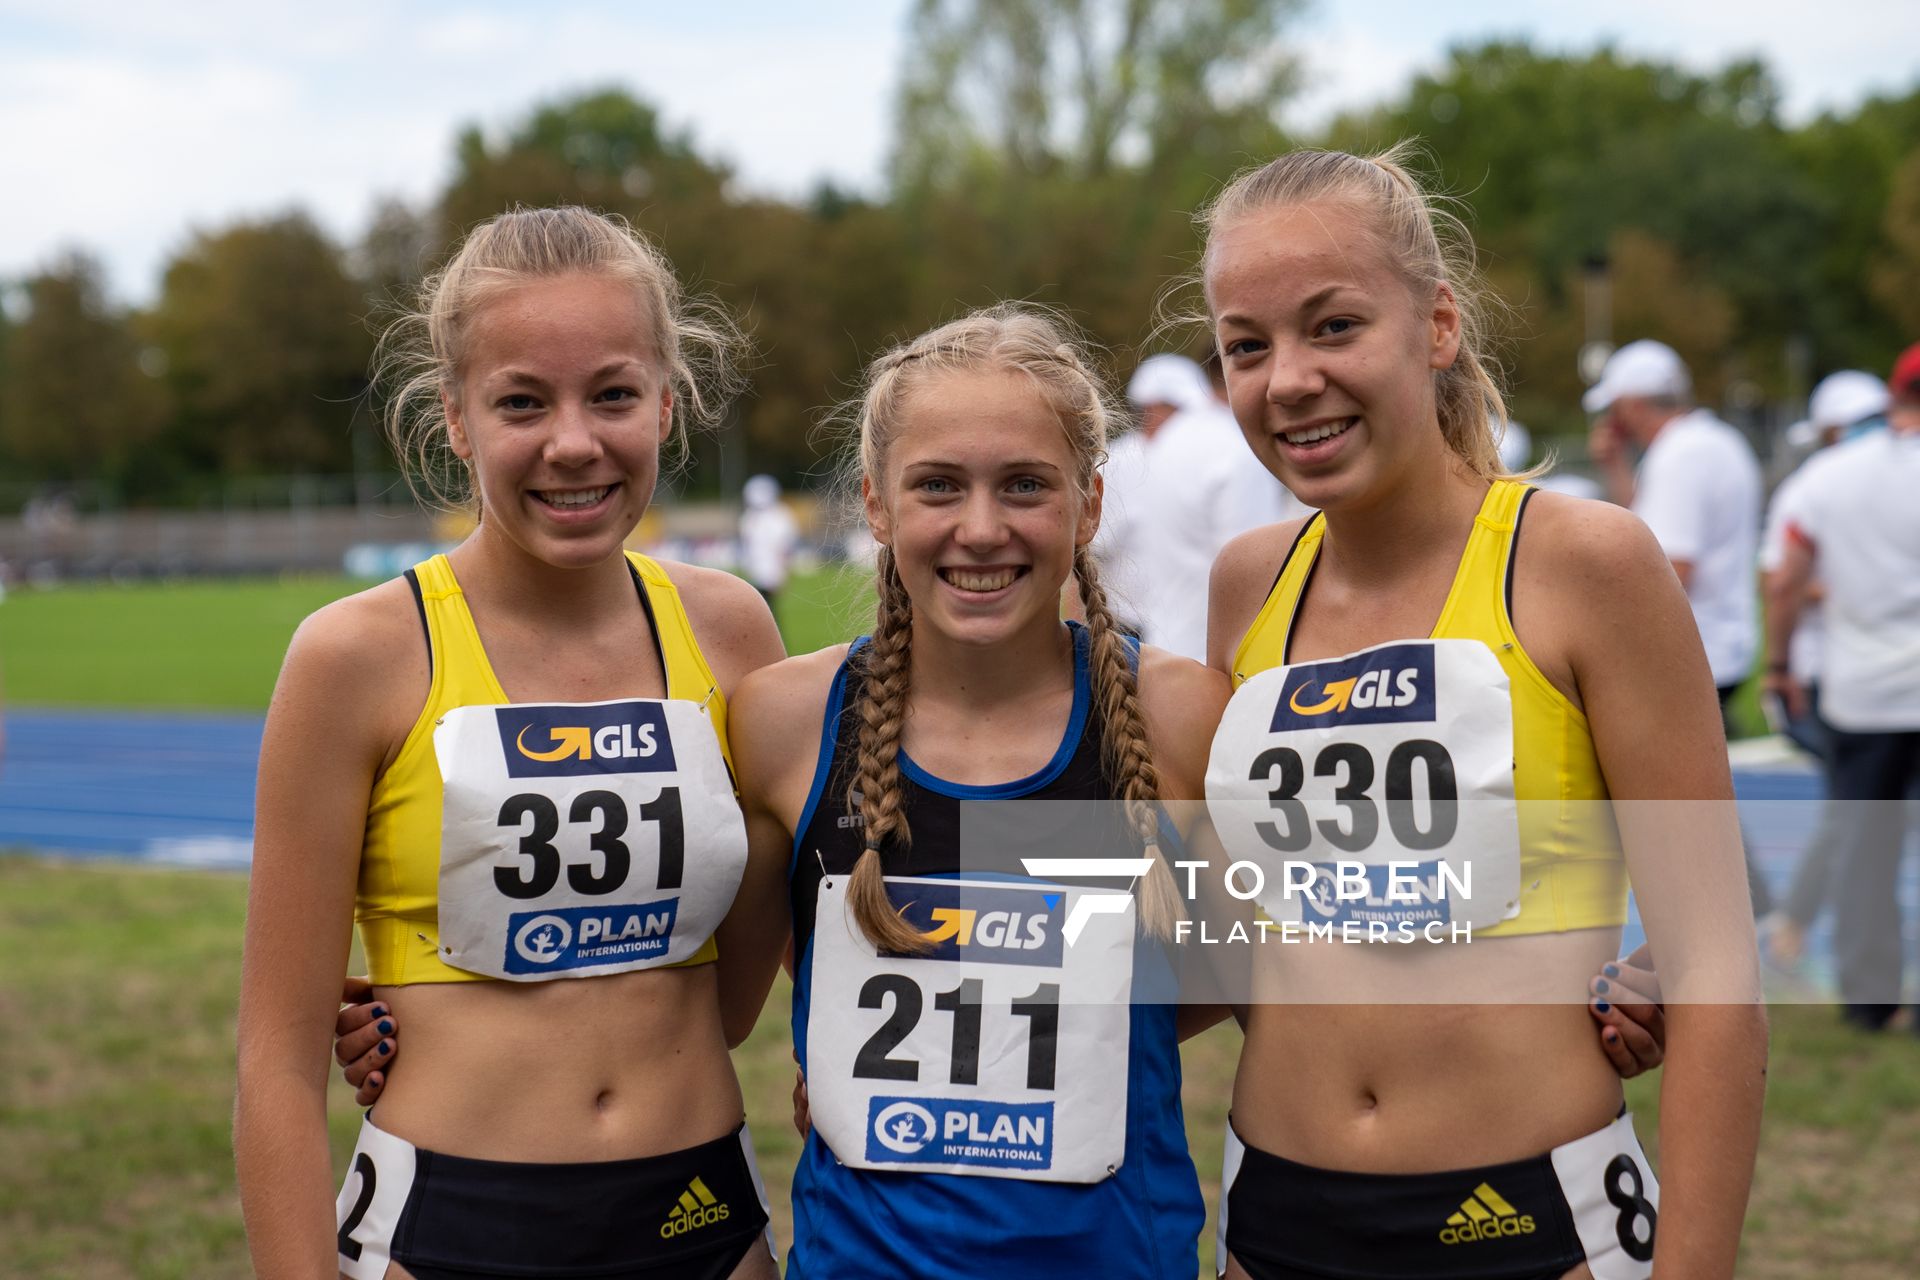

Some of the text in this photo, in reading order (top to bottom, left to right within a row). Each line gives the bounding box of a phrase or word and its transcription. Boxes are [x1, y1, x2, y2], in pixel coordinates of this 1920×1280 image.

[1351, 668, 1418, 709] GLS
[593, 723, 657, 759] GLS
[1248, 739, 1458, 853] 330
[493, 786, 685, 899] 331
[578, 912, 670, 944] PLAN
[975, 911, 1048, 950] GLS
[1351, 909, 1441, 922] INTERNATIONAL
[577, 939, 662, 958] INTERNATIONAL
[852, 973, 1060, 1091] 211
[943, 1110, 1046, 1146] PLAN
[943, 1144, 1043, 1161] INTERNATIONAL
[337, 1152, 376, 1262] 2
[661, 1203, 730, 1239] adidas
[1604, 1153, 1658, 1263] 8
[1439, 1213, 1536, 1245] adidas
